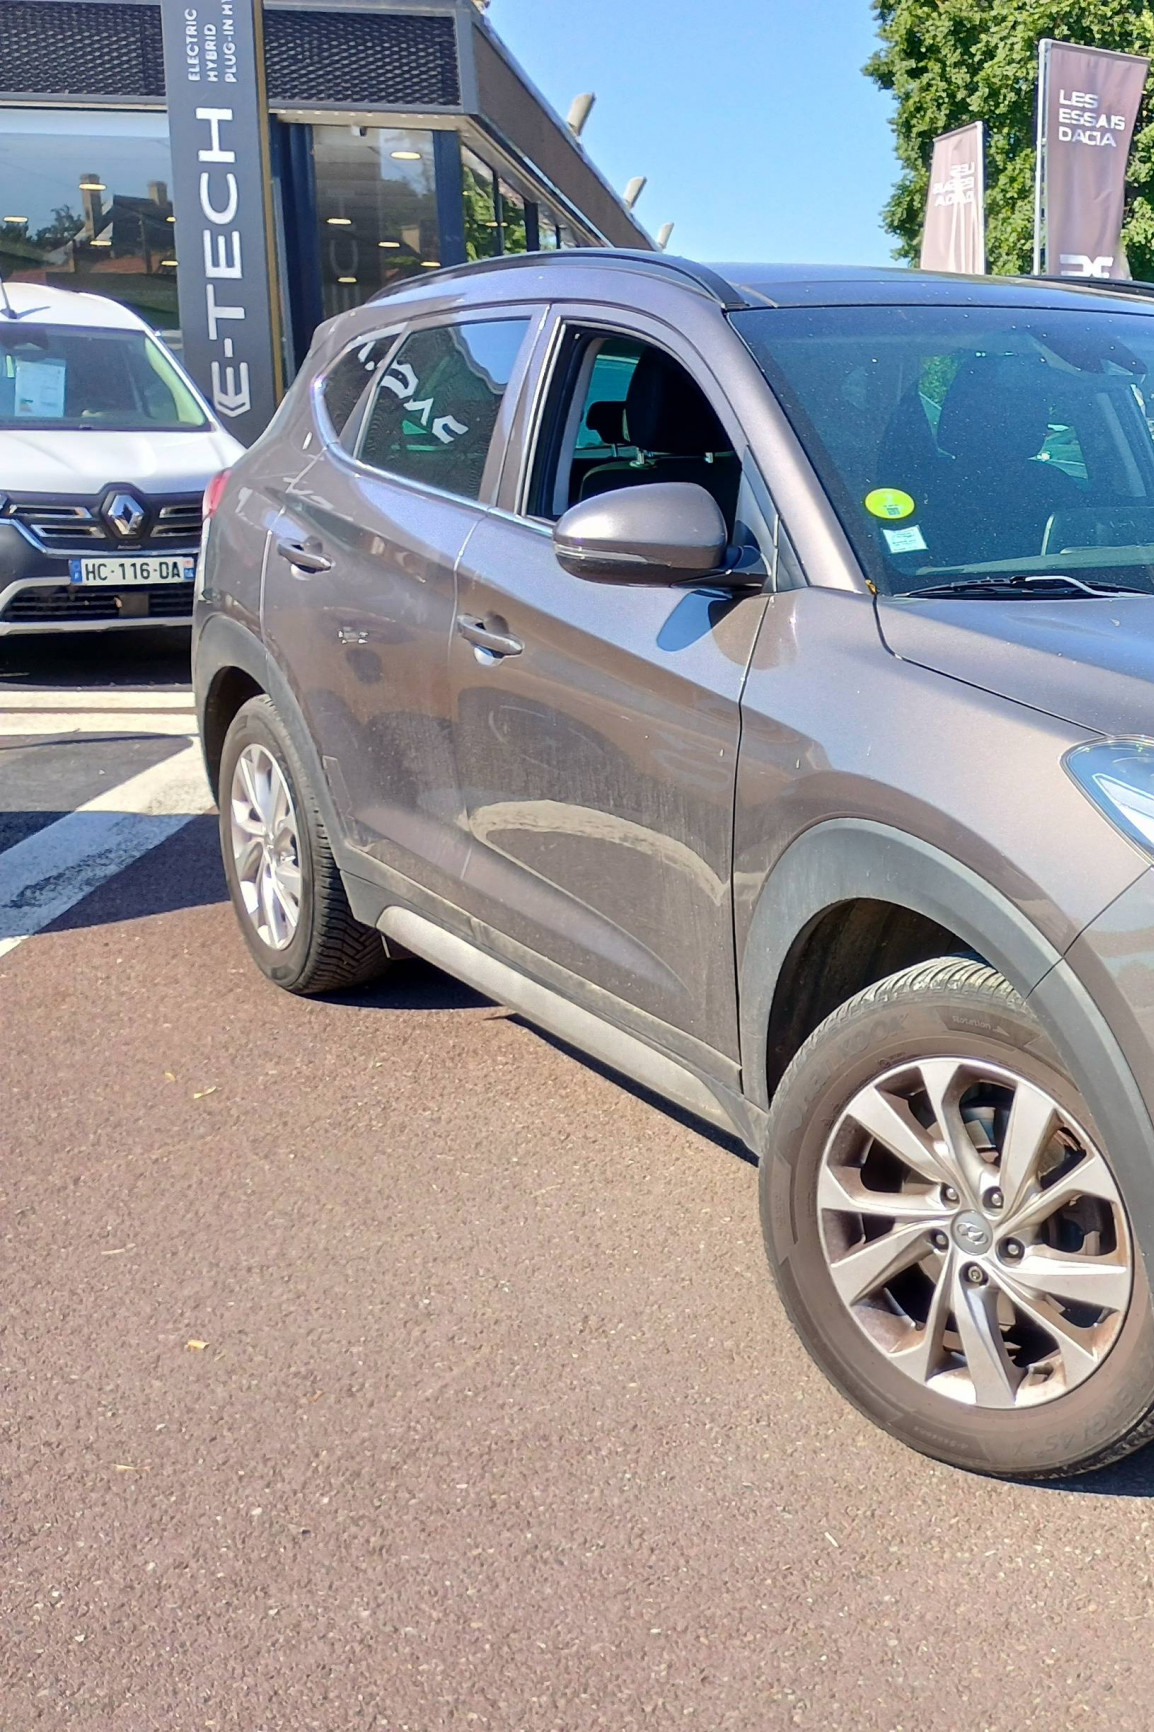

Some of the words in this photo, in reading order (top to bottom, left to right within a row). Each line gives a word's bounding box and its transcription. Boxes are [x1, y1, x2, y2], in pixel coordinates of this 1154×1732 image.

[184, 8, 201, 81] ELECTRIC
[203, 23, 218, 82] HYBRID
[221, 18, 237, 83] PLUG-IN
[1058, 108, 1126, 131] ESSAIS
[1059, 89, 1099, 109] LES
[1058, 126, 1117, 147] DACIA
[195, 107, 251, 418] E-TECH
